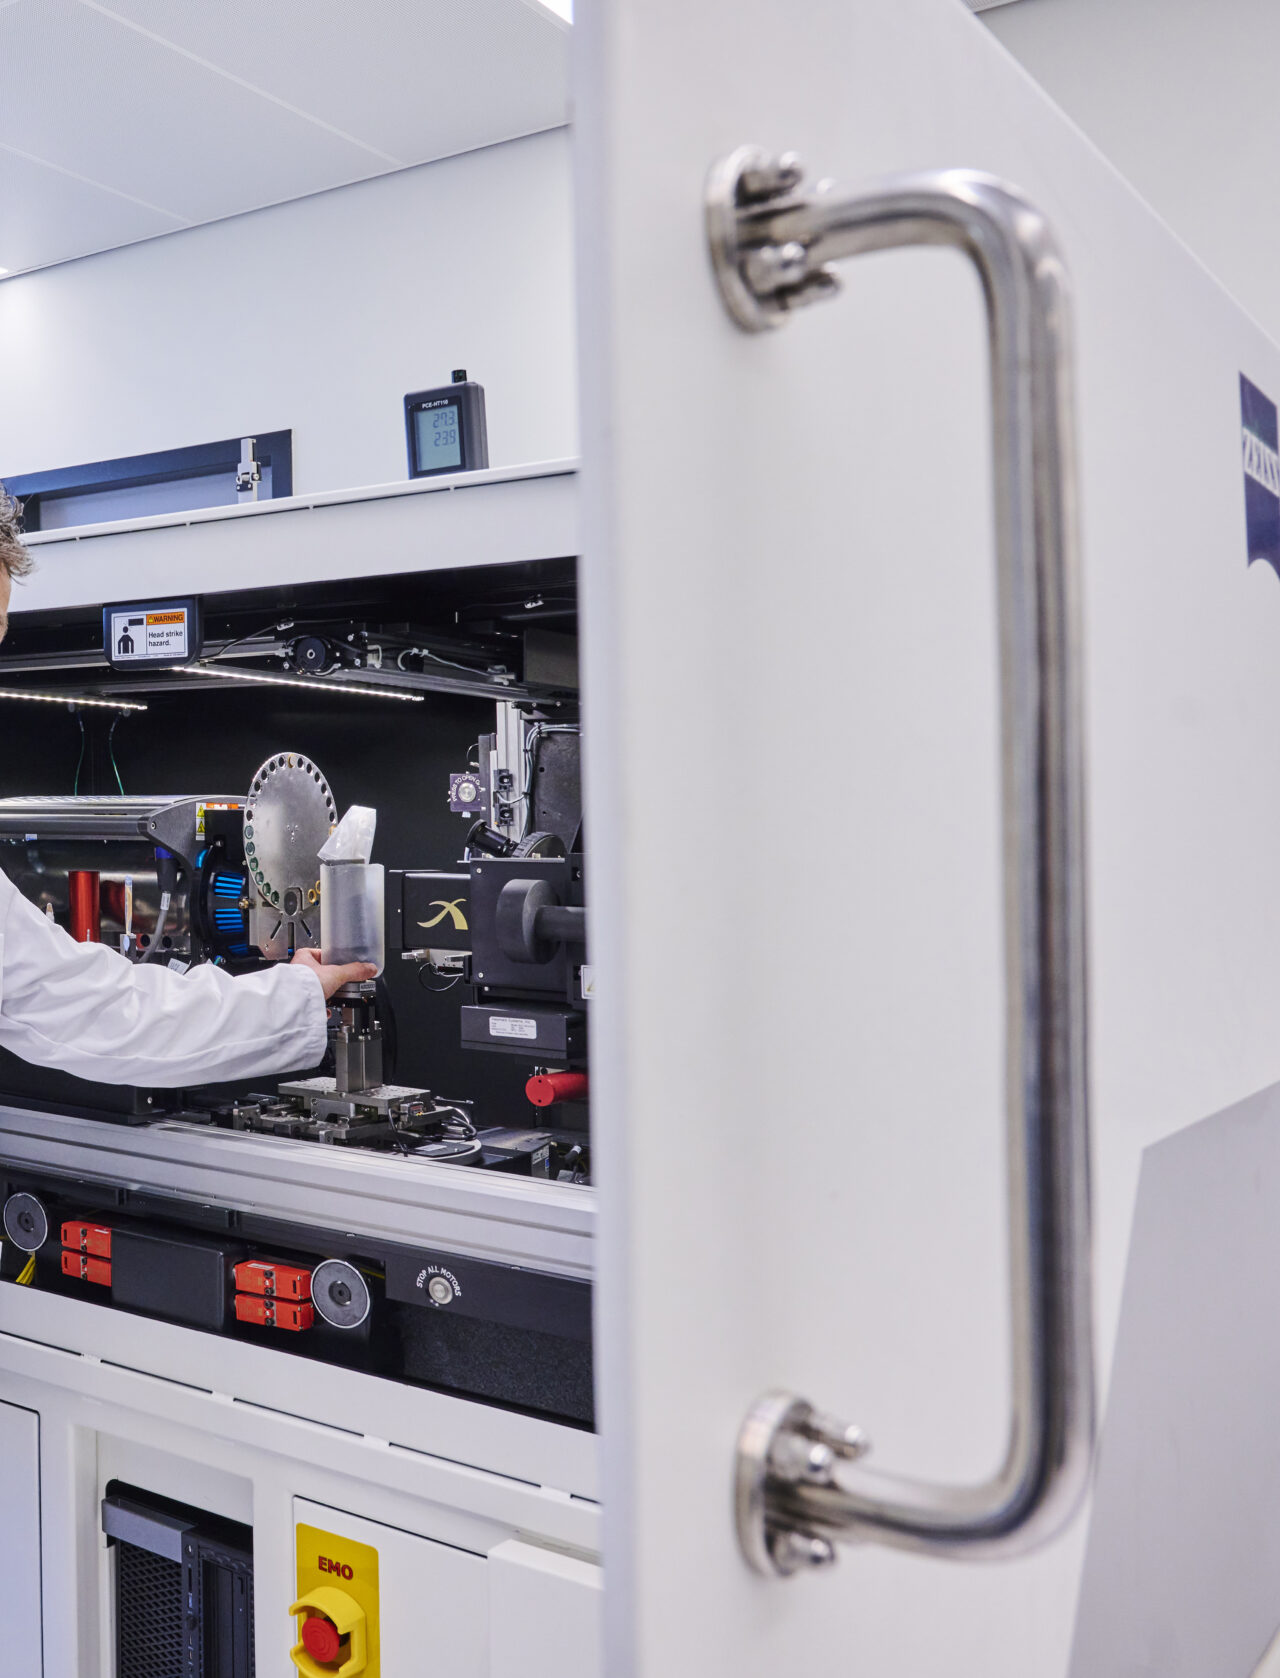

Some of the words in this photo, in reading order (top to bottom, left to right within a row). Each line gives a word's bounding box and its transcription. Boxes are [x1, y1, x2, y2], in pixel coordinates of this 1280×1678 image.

[154, 614, 183, 623] WARNING
[416, 1269, 427, 1288] STOP
[427, 1265, 439, 1274] ALL
[440, 1267, 462, 1296] MOTORS
[318, 1555, 353, 1580] EMO
